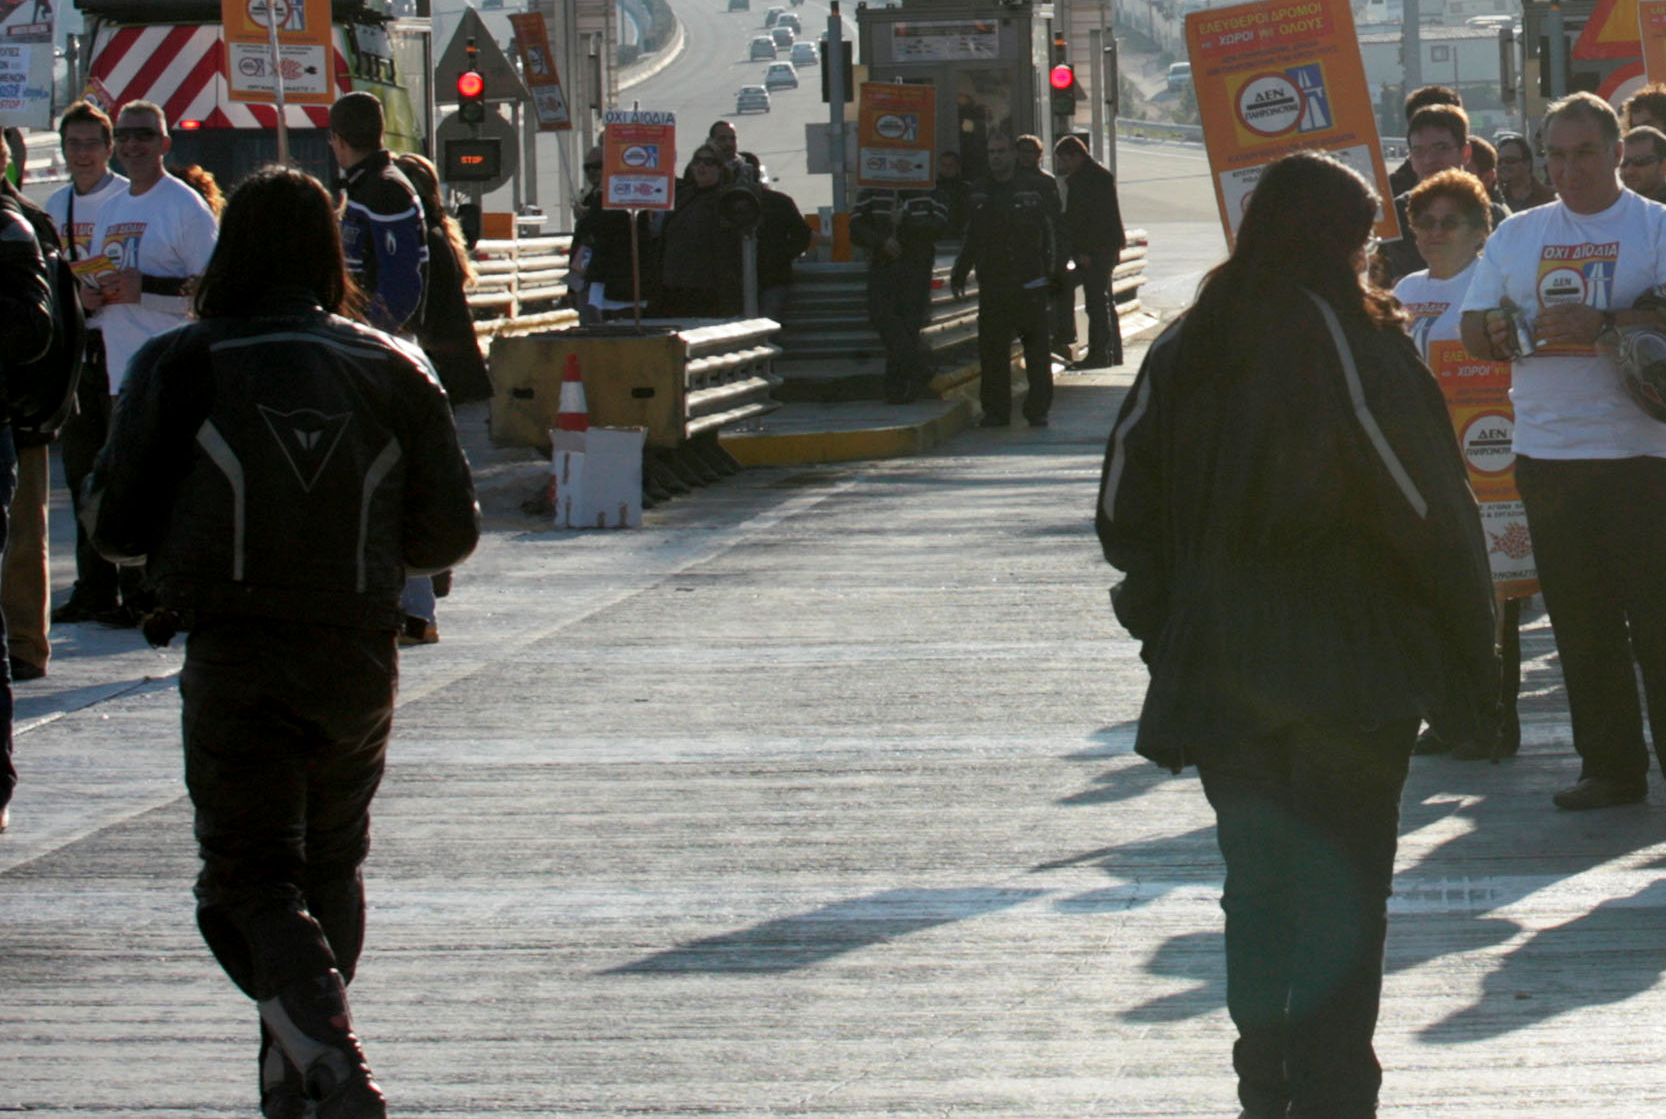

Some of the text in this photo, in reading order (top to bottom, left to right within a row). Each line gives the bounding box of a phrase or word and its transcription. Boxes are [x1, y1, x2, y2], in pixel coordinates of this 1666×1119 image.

[1200, 1, 1322, 35] ΕΛΕΥΘΕΡΟΙ ΔΡΟΜΟΙ
[1218, 31, 1254, 47] ΧΩΡΟΙ
[1279, 18, 1323, 35] ΟΛΟΥΣ
[1255, 87, 1285, 103] ΔΕΝ
[606, 111, 675, 124] ΟΧΙ ΔΙΟΔΙΑ
[461, 155, 484, 164] STOP
[1544, 244, 1618, 259] ΟΧΙ ΔΙΟΔΙΑ
[1553, 277, 1572, 287] ΔΕΝ
[1457, 365, 1491, 377] ΧΩΡΟΙ
[1478, 429, 1507, 439] ΔΕΝ
